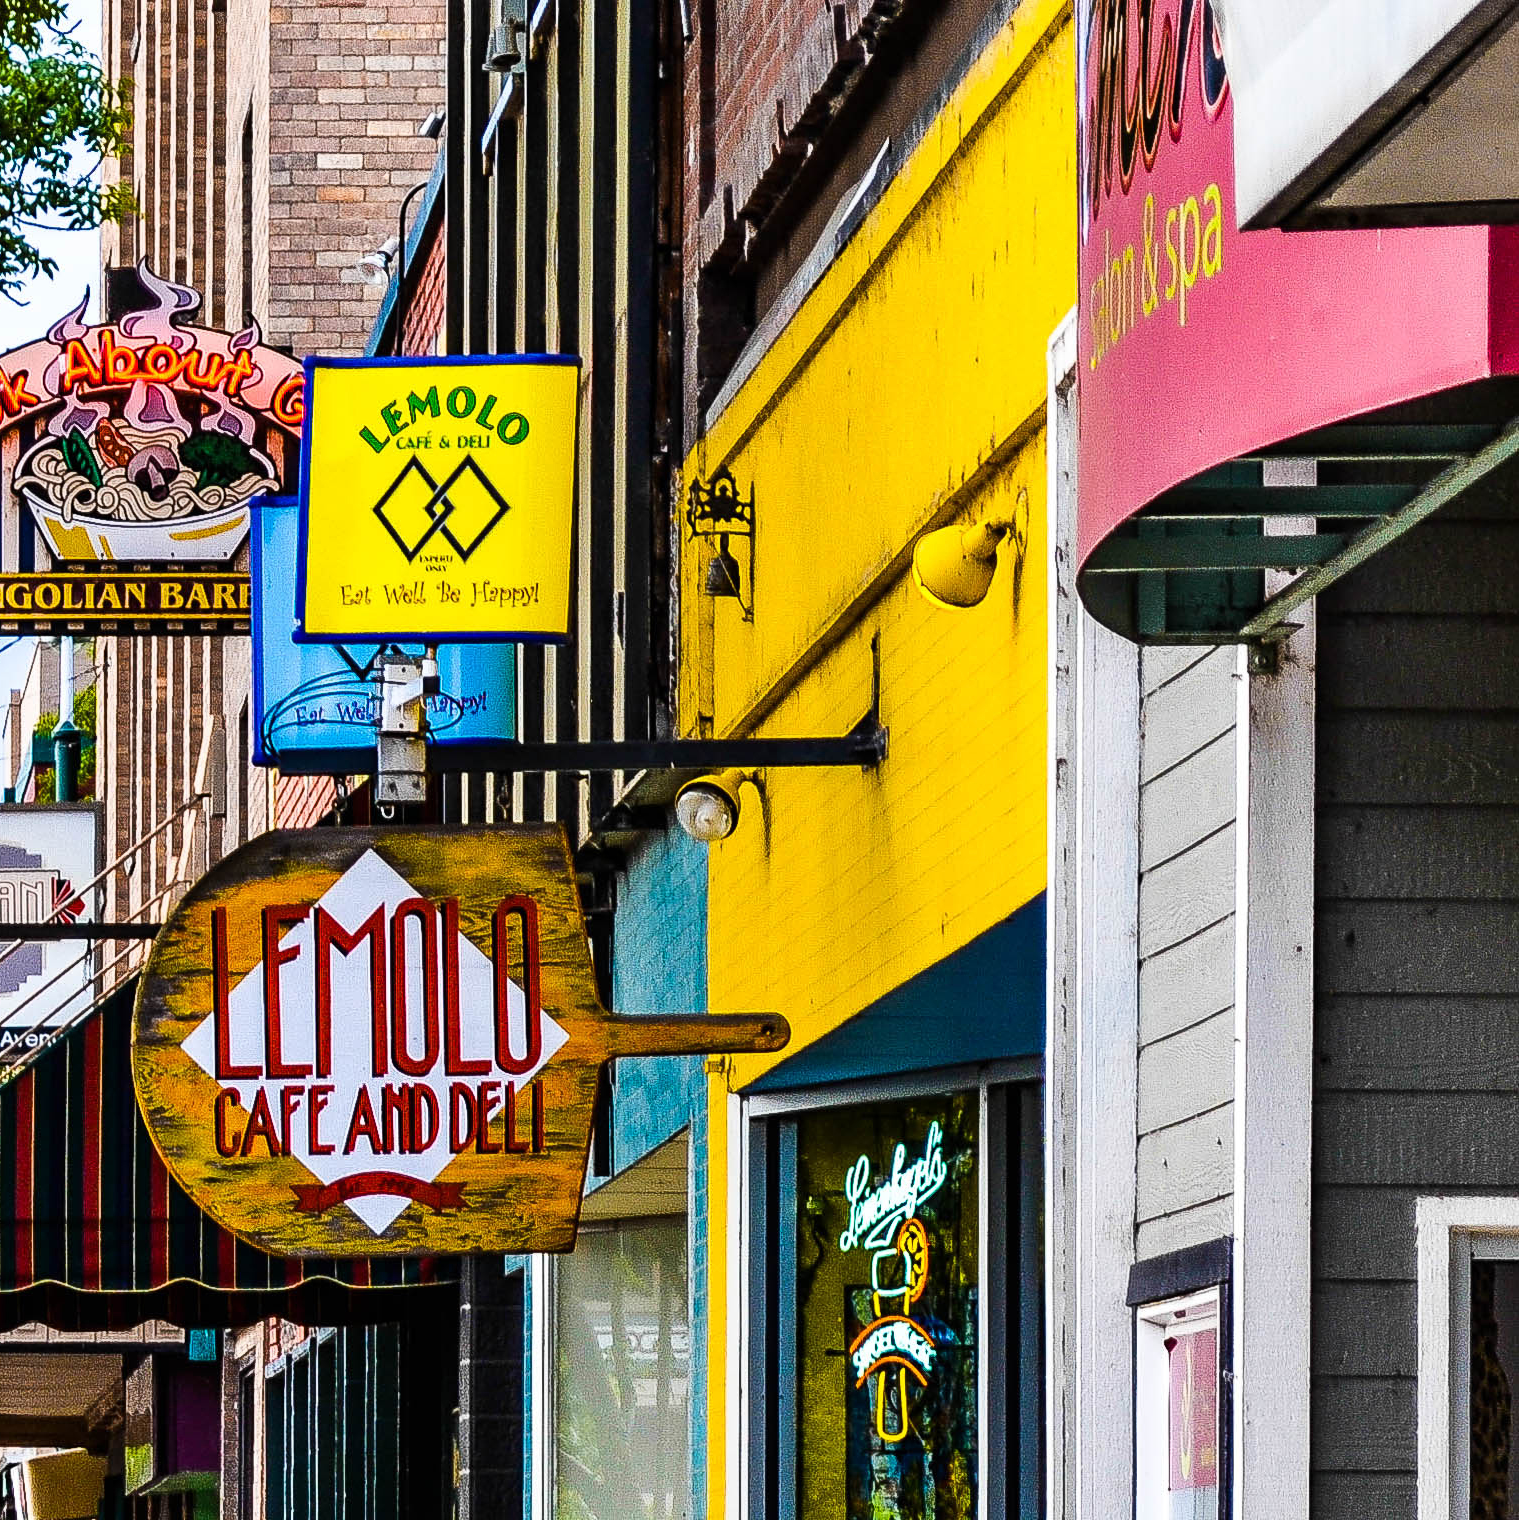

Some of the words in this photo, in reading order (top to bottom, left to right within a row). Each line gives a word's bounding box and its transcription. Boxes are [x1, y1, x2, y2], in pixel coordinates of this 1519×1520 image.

[1142, 193, 1159, 316] &
[1166, 183, 1222, 327] spa
[61, 329, 254, 395] About
[359, 385, 530, 454] LEMOLO
[395, 431, 432, 449] CAFÉ
[439, 436, 450, 448] &
[457, 435, 490, 448] DELI
[340, 585, 371, 605] Eat
[384, 581, 426, 604] Well
[437, 580, 460, 603] Be
[470, 581, 539, 607] Happy!
[294, 705, 324, 726] Eat
[425, 691, 488, 717] appy!
[211, 894, 542, 1081] LEMOLO
[0, 1030, 61, 1048] Aven
[214, 1084, 336, 1157] CAFE
[343, 1082, 440, 1156] AND
[449, 1080, 545, 1156] DELI
